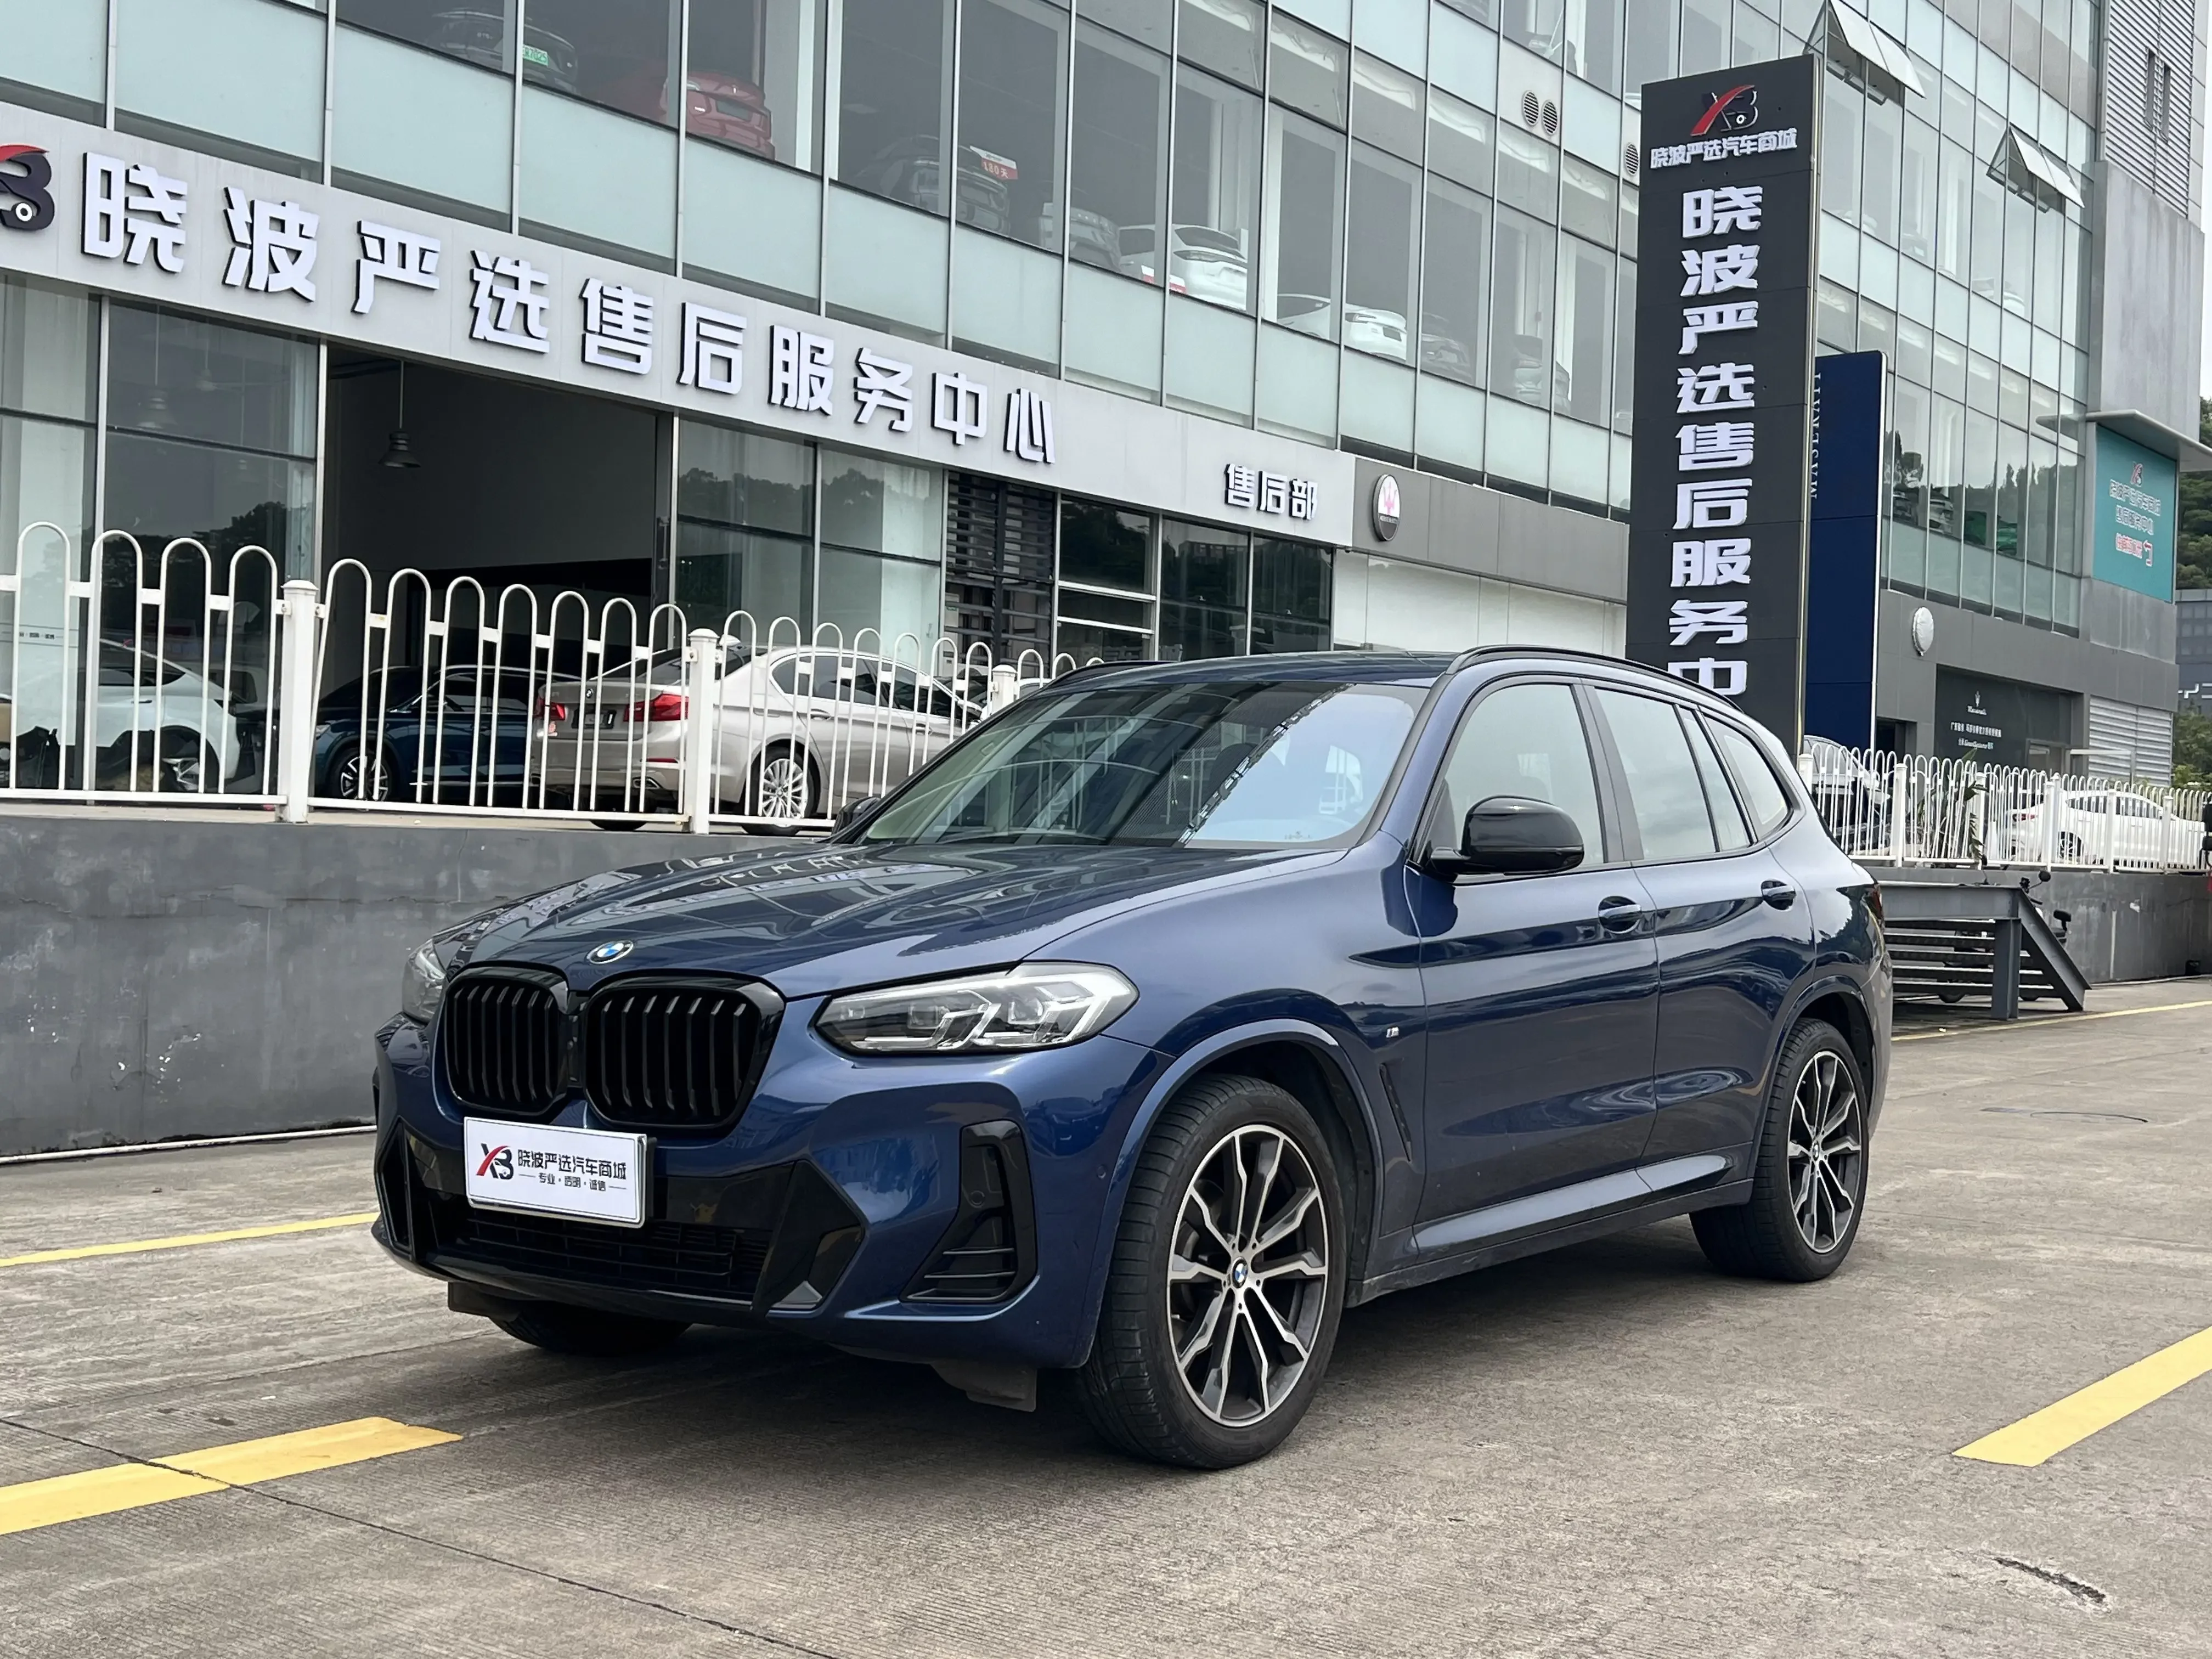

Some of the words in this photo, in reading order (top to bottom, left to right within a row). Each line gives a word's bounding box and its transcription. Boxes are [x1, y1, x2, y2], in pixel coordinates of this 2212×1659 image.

[1650, 128, 1798, 169] 晓波严选汽车商城
[82, 152, 1056, 464] 晓波严选售后服务中心
[1668, 187, 1763, 696] 晓波严选售后服务中
[1224, 463, 1318, 521] 售后部
[518, 1149, 627, 1180] 晓波严选汽车商城
